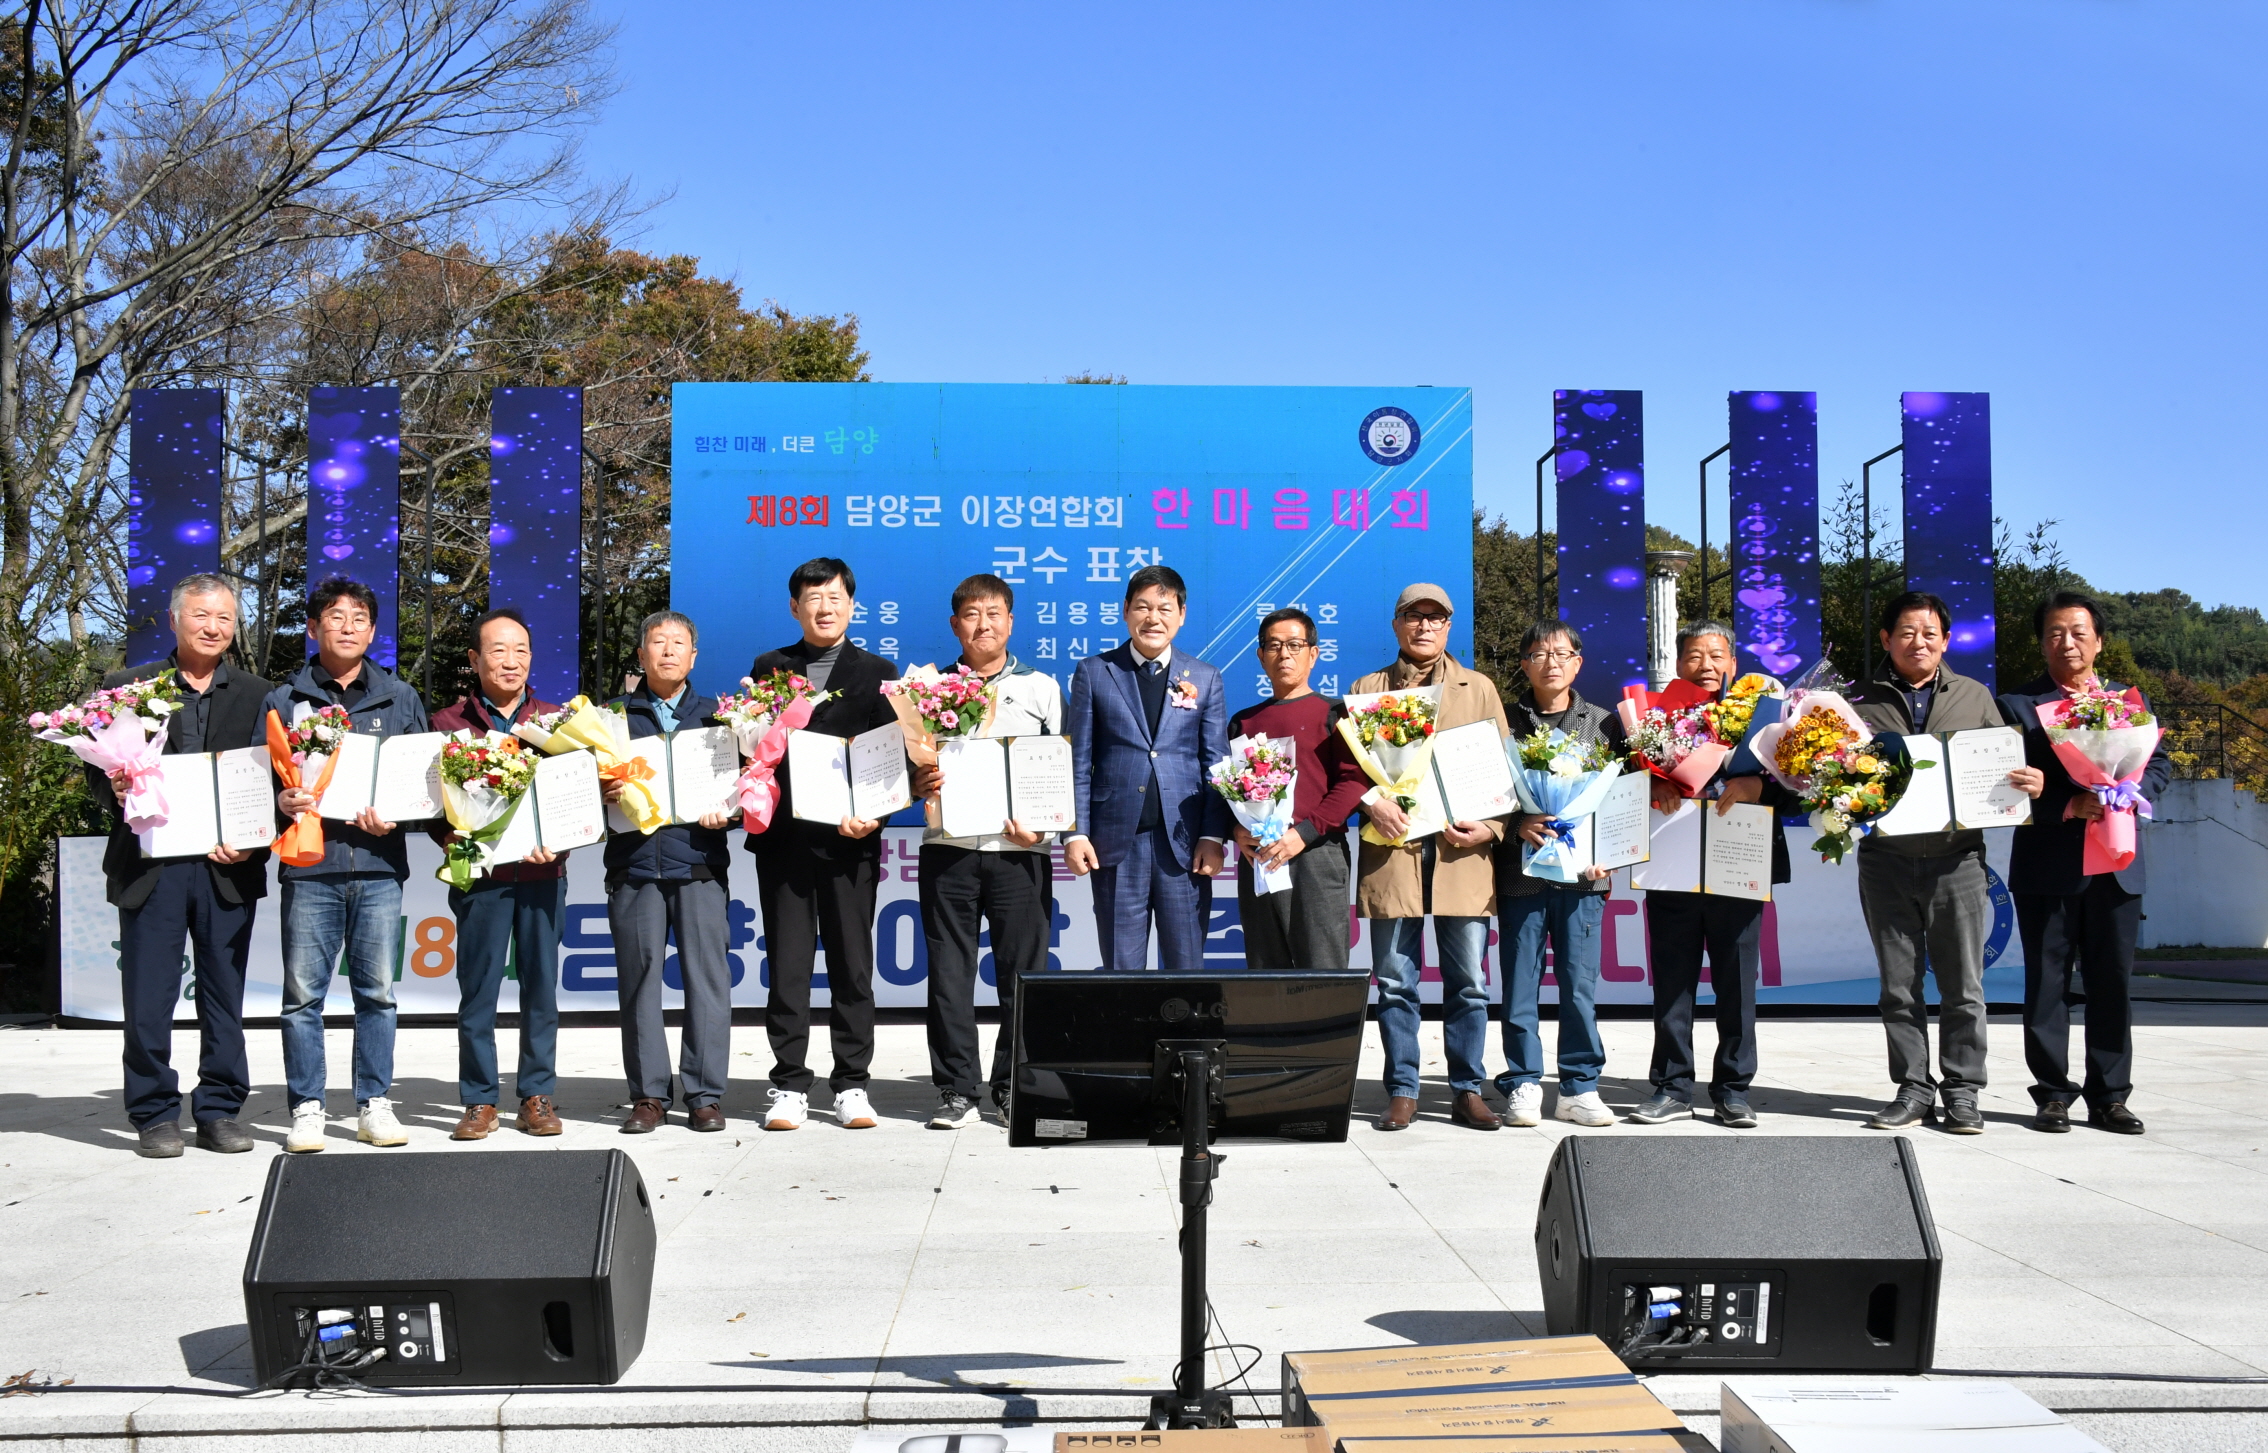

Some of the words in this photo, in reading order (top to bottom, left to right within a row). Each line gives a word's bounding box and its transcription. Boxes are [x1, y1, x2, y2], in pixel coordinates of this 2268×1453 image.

[695, 436, 728, 453] 힘찬
[734, 436, 766, 453] 미래
[783, 436, 815, 453] 더큰
[824, 426, 879, 455] 담양
[746, 494, 829, 527] 제8회
[846, 494, 942, 527] 담양군
[962, 495, 1123, 528] 이장연합회
[992, 546, 1069, 584] 군수
[1197, 1002, 1228, 1018] LG
